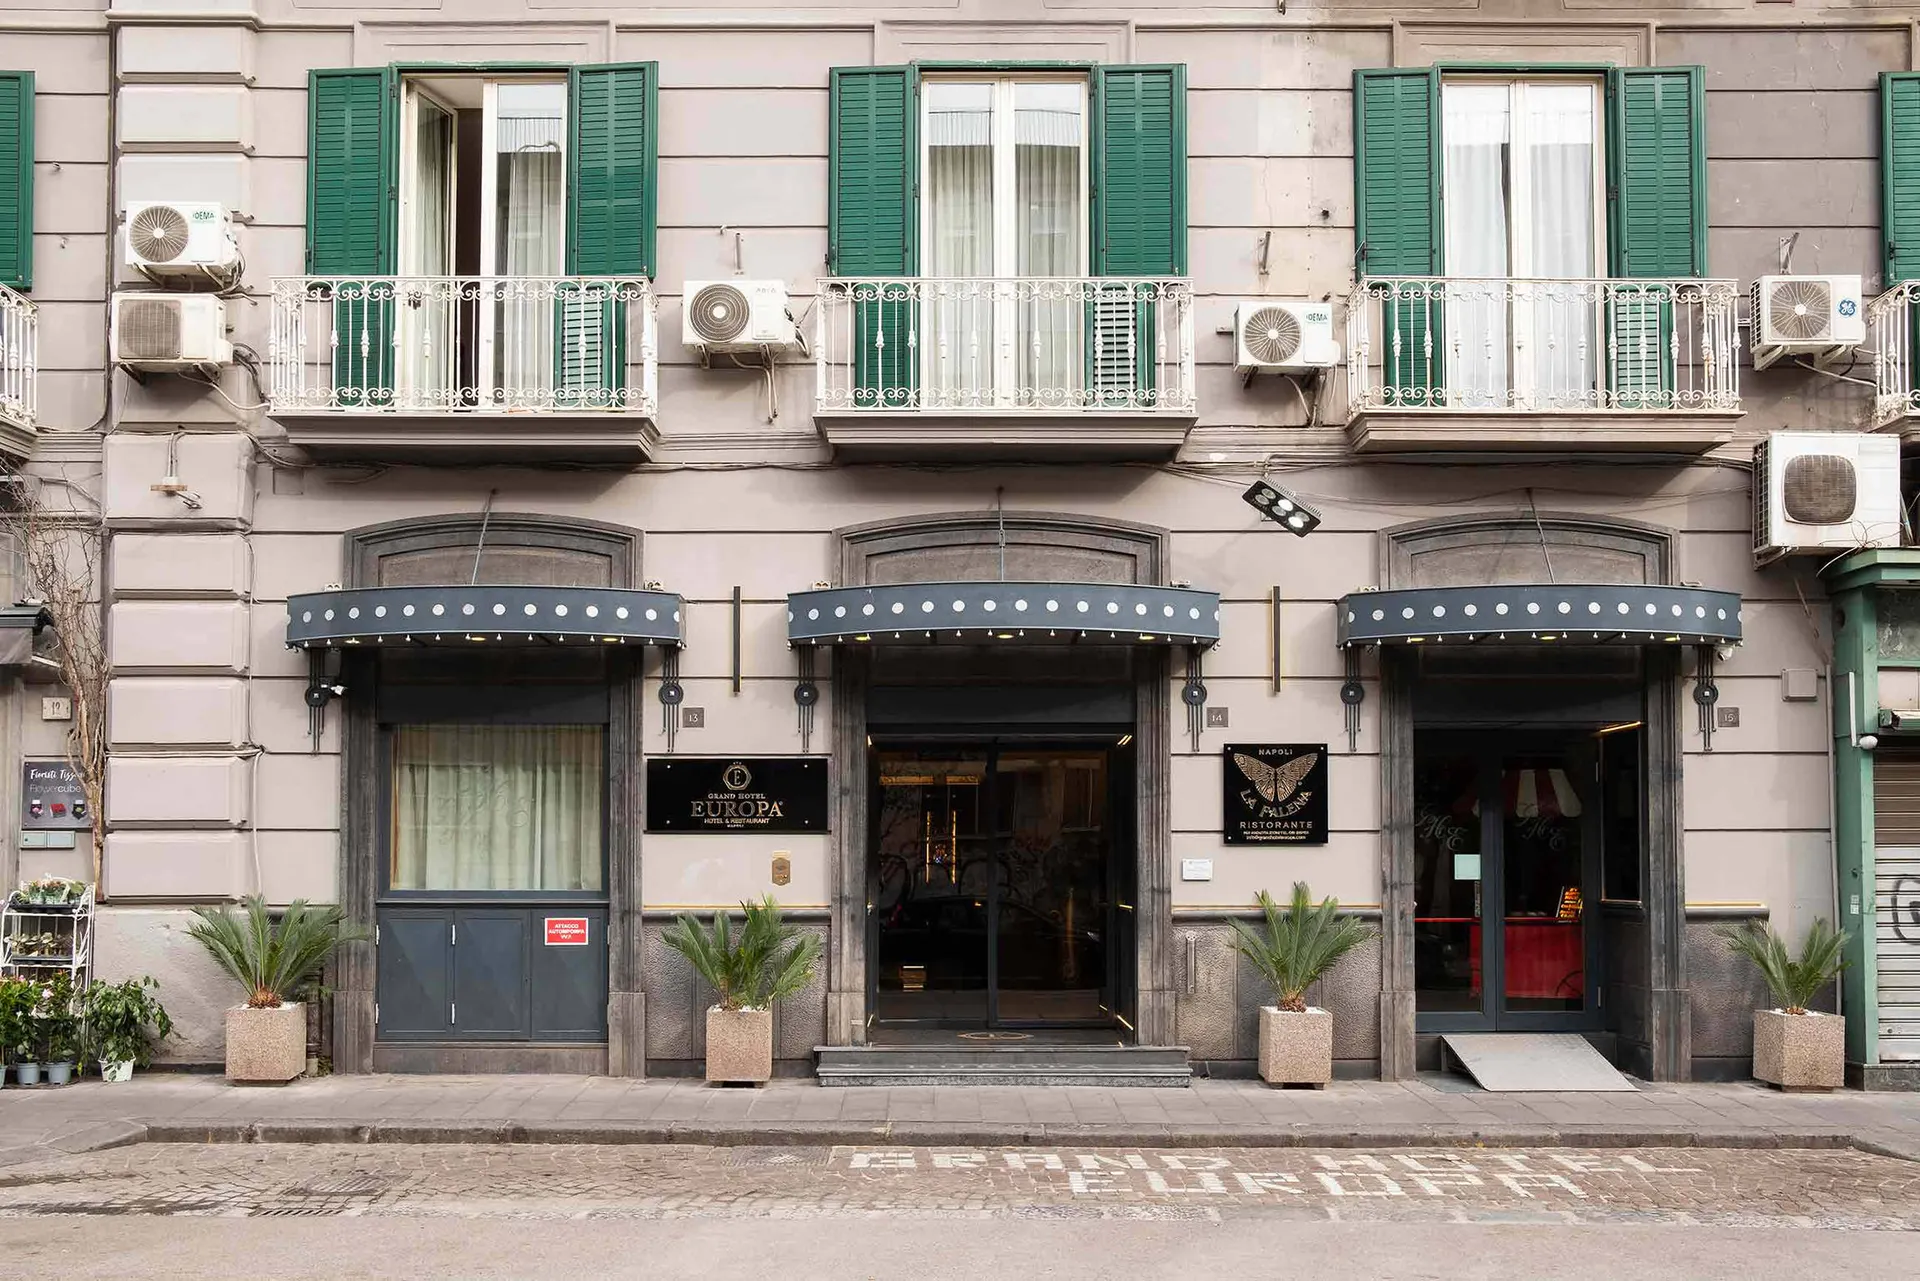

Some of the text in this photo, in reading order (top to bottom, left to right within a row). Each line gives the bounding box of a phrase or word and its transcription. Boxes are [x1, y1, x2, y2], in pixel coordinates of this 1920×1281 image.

[689, 713, 699, 722] 13
[1212, 714, 1223, 722] 14
[1240, 789, 1257, 810] LA
[691, 801, 784, 817] EUROPA
[1240, 821, 1313, 829] RISTORANTE
[848, 1152, 1704, 1173] GRAND HOTEL
[1068, 1171, 1590, 1200] EUROPA
